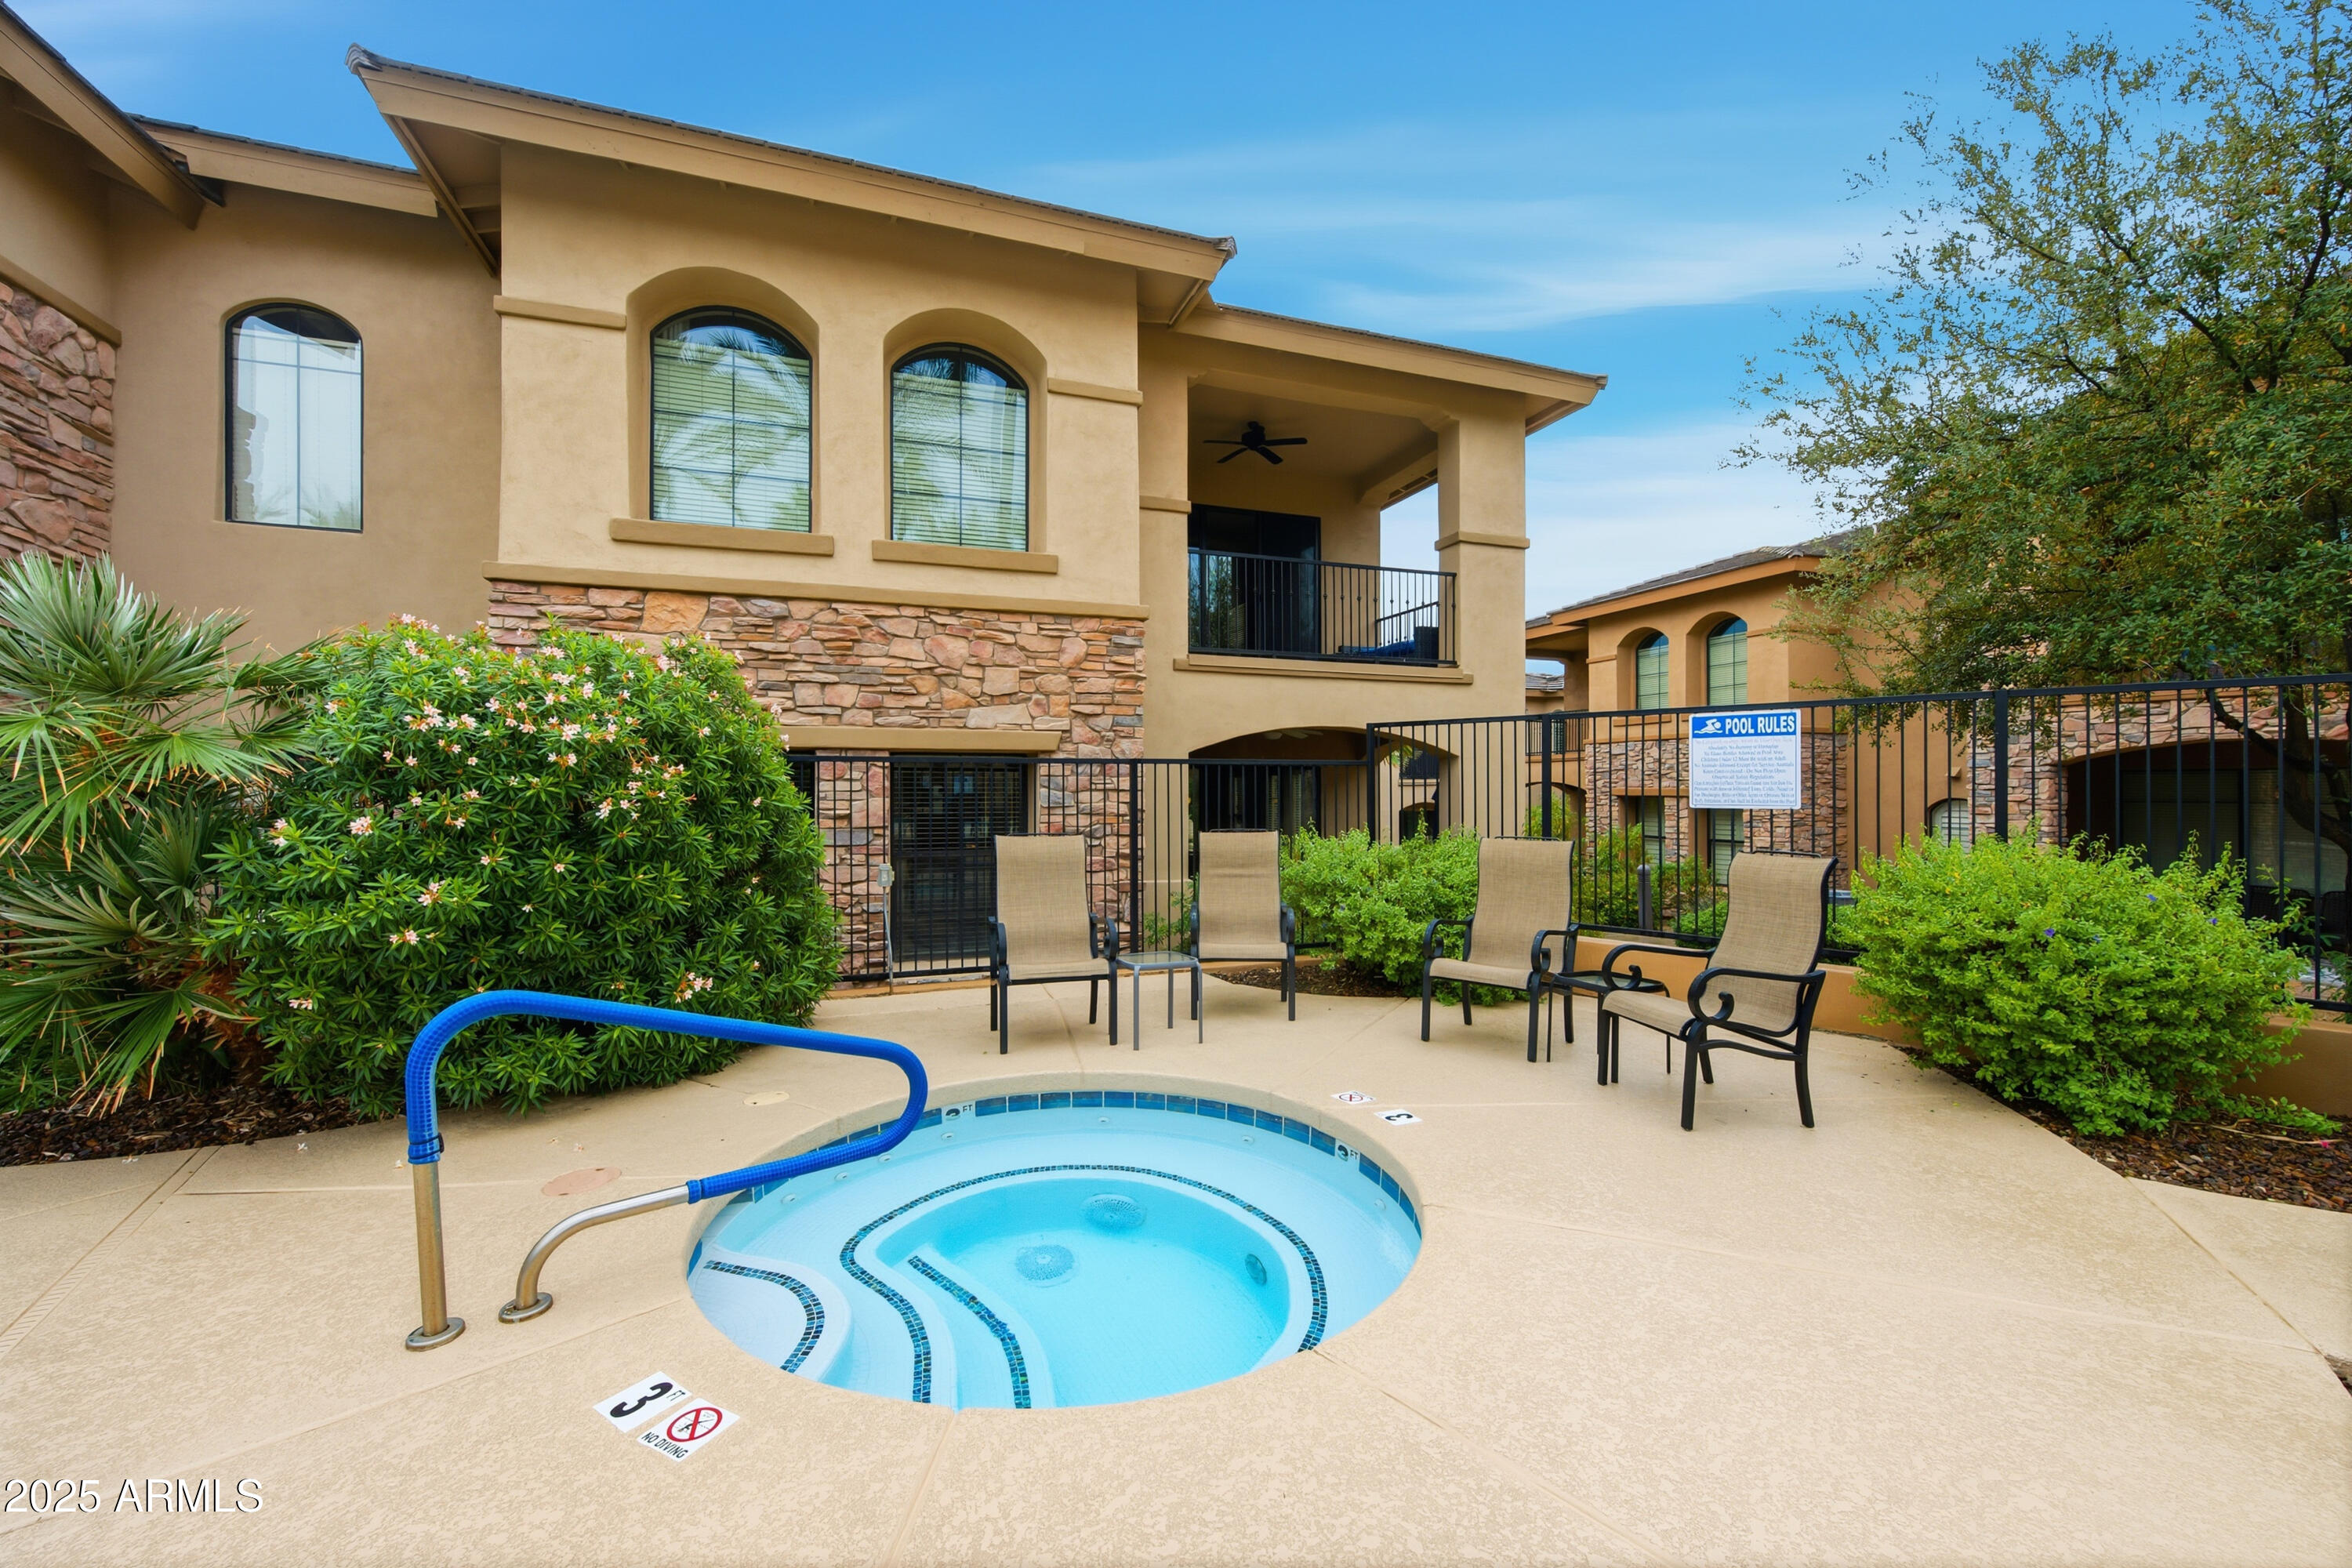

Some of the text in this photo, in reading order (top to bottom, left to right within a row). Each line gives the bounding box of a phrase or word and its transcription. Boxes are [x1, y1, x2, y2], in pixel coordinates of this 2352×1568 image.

[1725, 715, 1795, 735] POOL RULES
[962, 1104, 973, 1112] FT
[1385, 1112, 1414, 1121] 3
[1349, 1149, 1359, 1160] FT
[609, 1381, 686, 1418] 3 FT
[641, 1432, 689, 1459] NO DIVING
